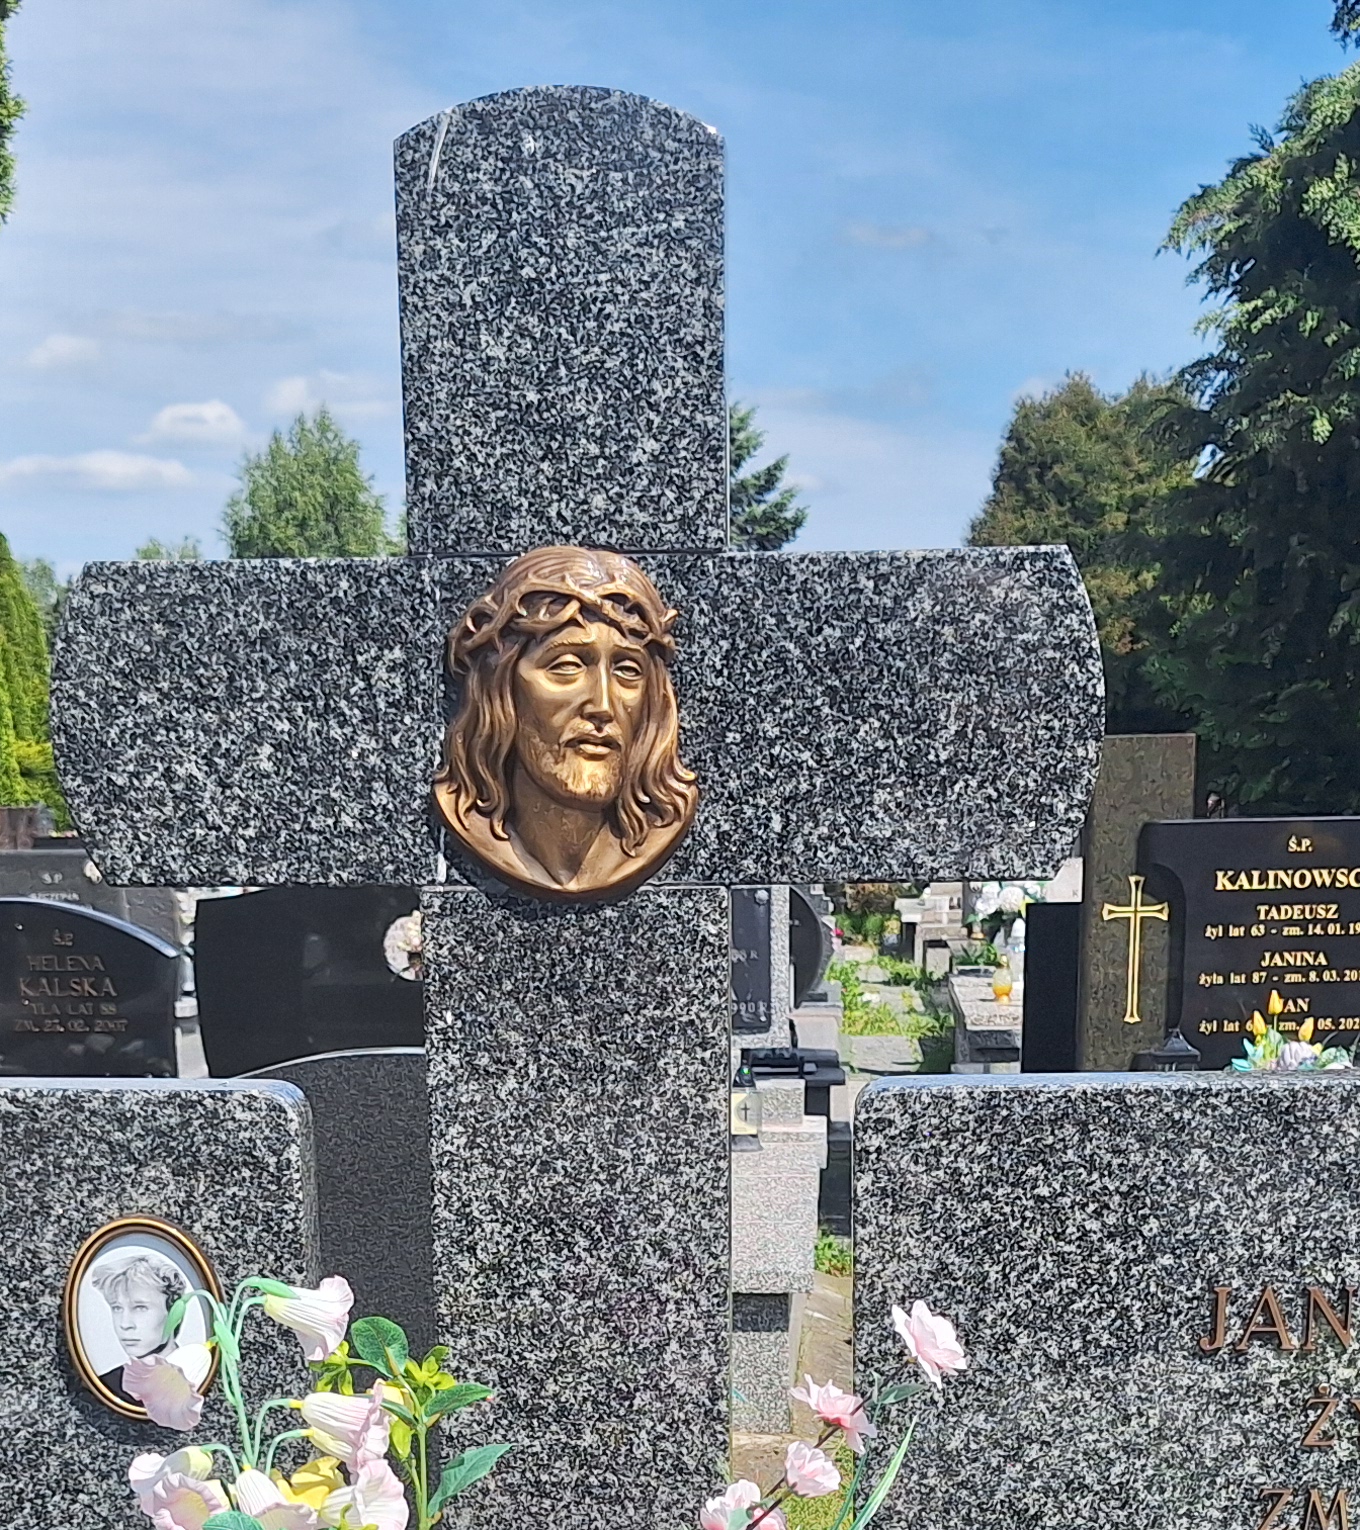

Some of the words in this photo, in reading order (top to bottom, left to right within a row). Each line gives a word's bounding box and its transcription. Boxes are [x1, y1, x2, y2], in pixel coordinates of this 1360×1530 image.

[1256, 903, 1340, 921] TADEUSZ
[1228, 924, 1245, 937] lat
[1250, 923, 1266, 937] 63
[1282, 925, 1304, 936] zm.
[1307, 923, 1325, 936] 14.
[1260, 951, 1328, 967] JANINA
[1230, 972, 1247, 984] lat
[1252, 971, 1268, 984] 87
[1284, 971, 1306, 984] zm.
[1322, 969, 1341, 982] 03.
[19, 977, 118, 997] KALSKA
[1223, 1019, 1240, 1032] lat
[1199, 1285, 1357, 1351] JAN
